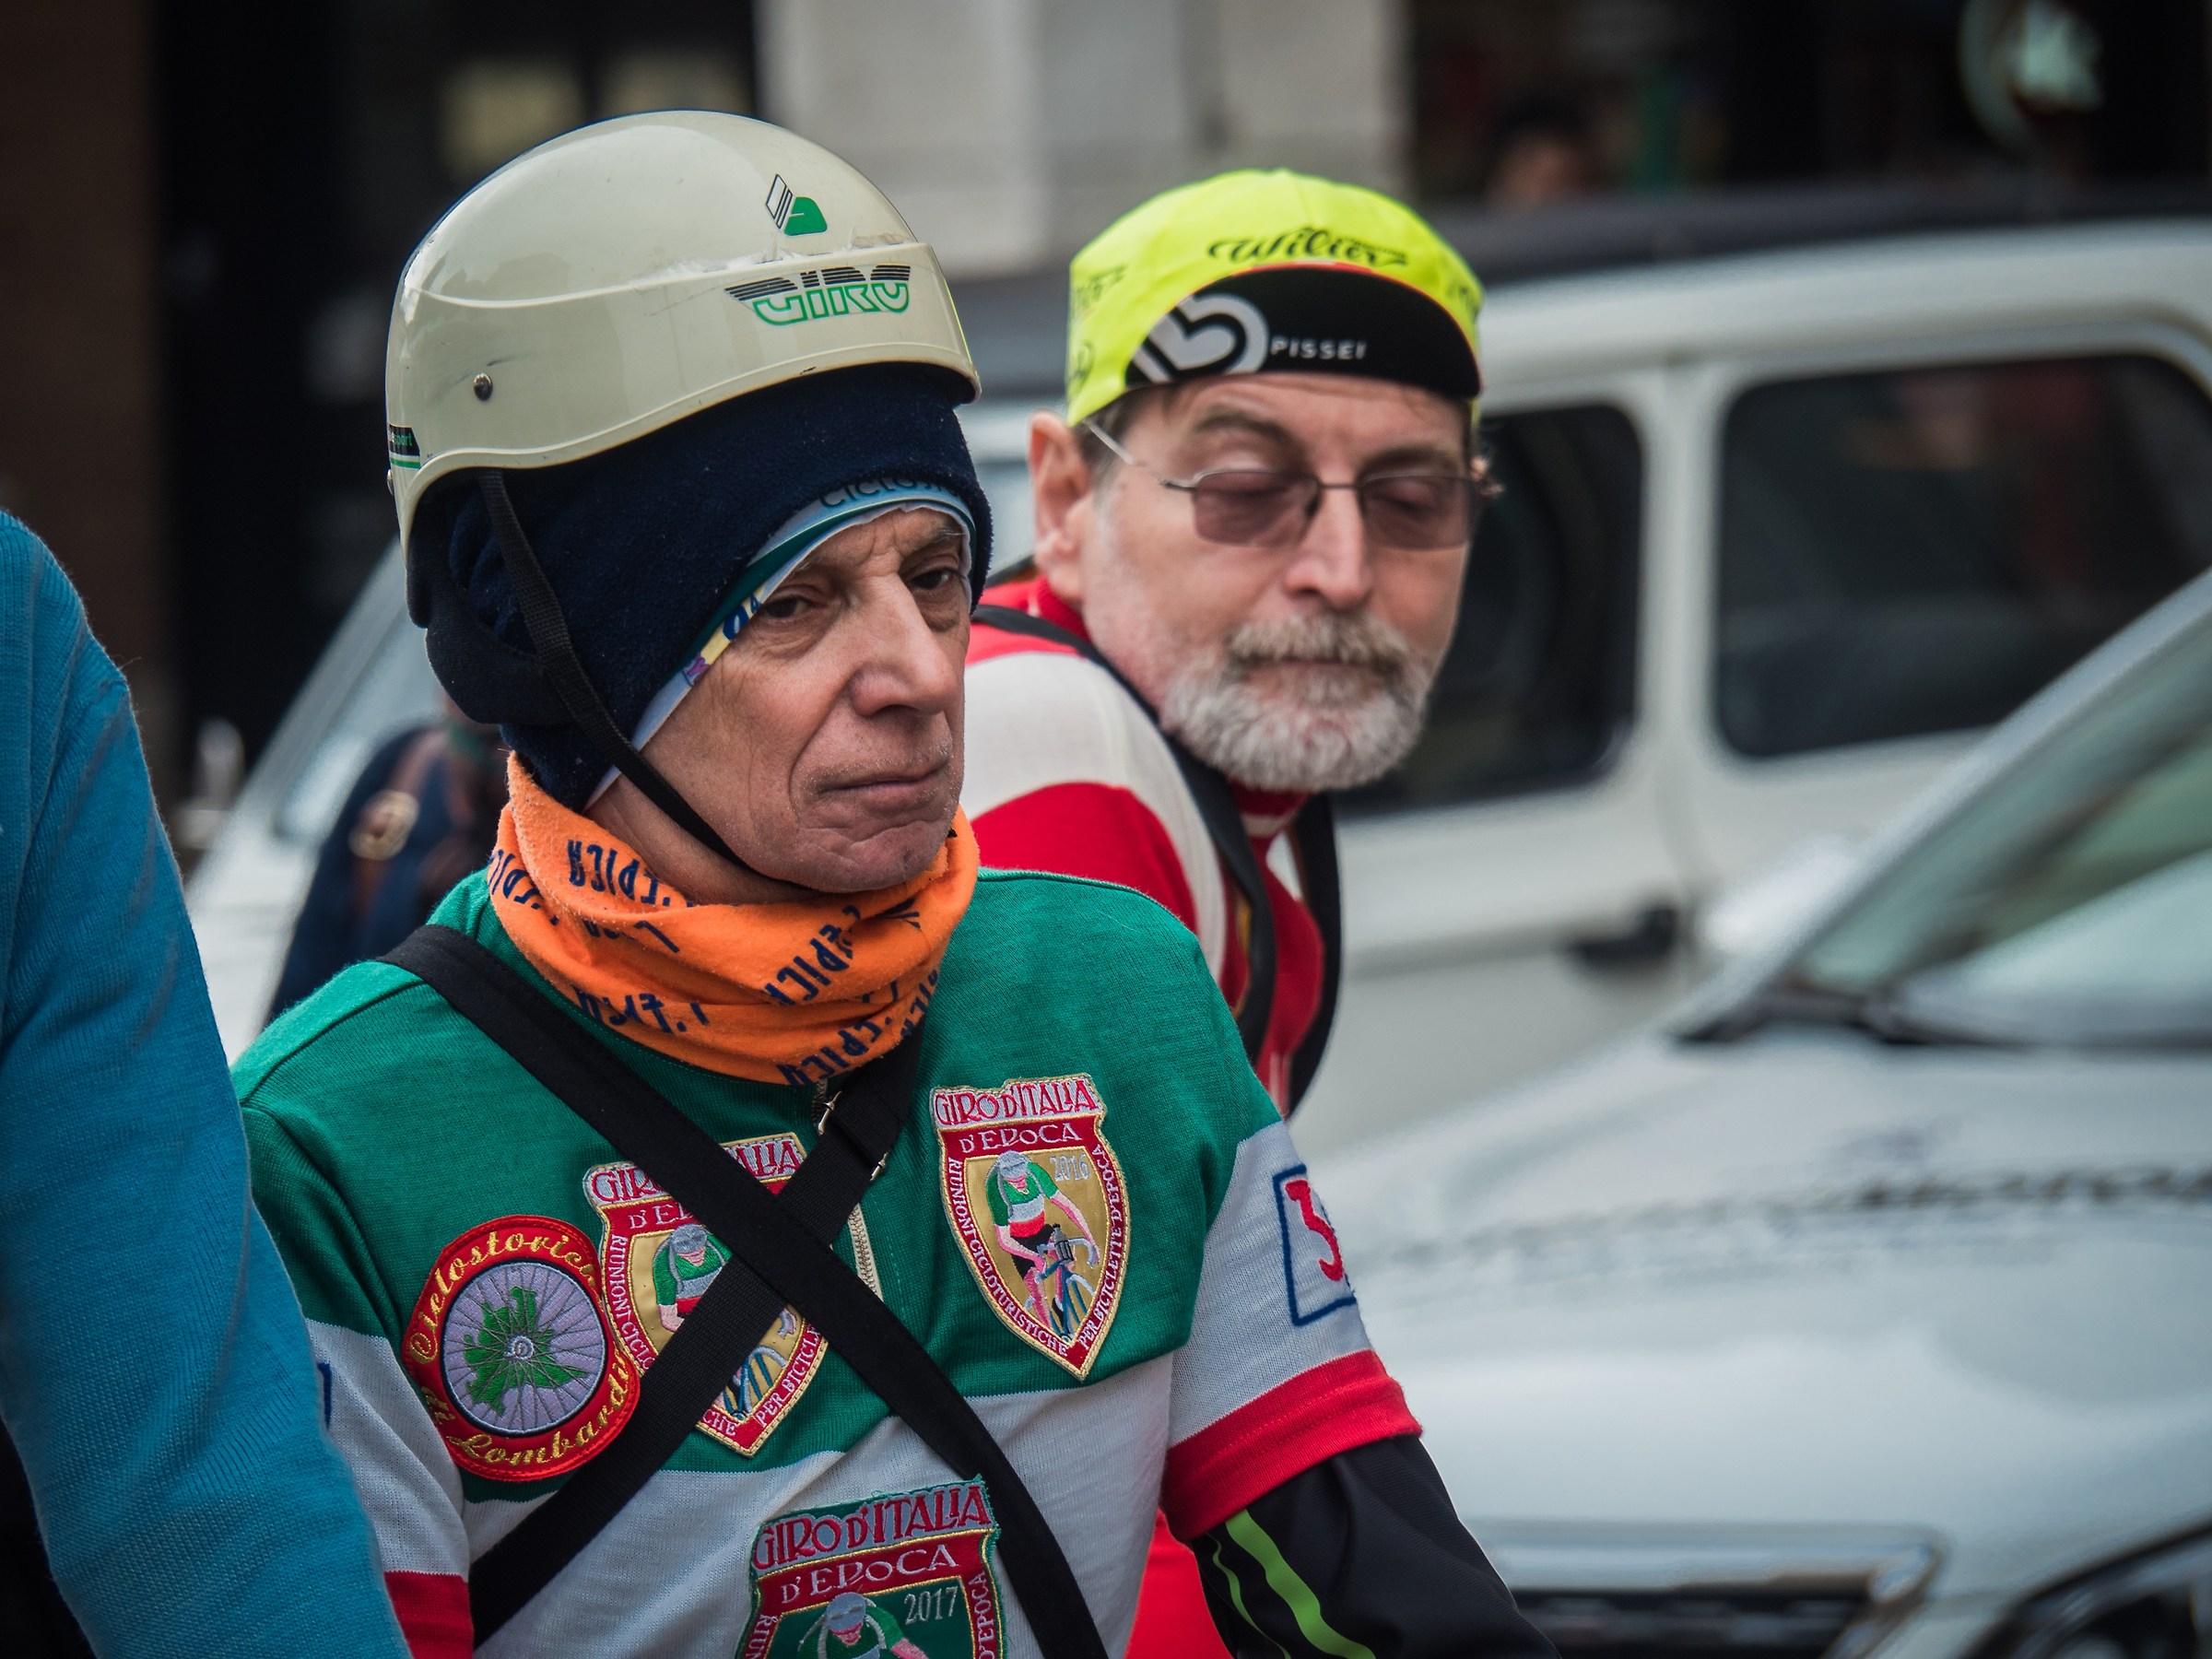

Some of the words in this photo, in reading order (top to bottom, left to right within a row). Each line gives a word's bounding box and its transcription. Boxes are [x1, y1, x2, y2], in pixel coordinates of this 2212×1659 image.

[724, 264, 912, 327] GIRO
[1270, 335, 1367, 360] PISSEI
[935, 1092, 1000, 1126] GIRO
[959, 1123, 1082, 1154] D'EPOCA
[1050, 1153, 1091, 1183] 2016
[752, 1515, 841, 1571] GIRO
[781, 1545, 959, 1605] D'EPOCA
[904, 1586, 959, 1626] 2017
